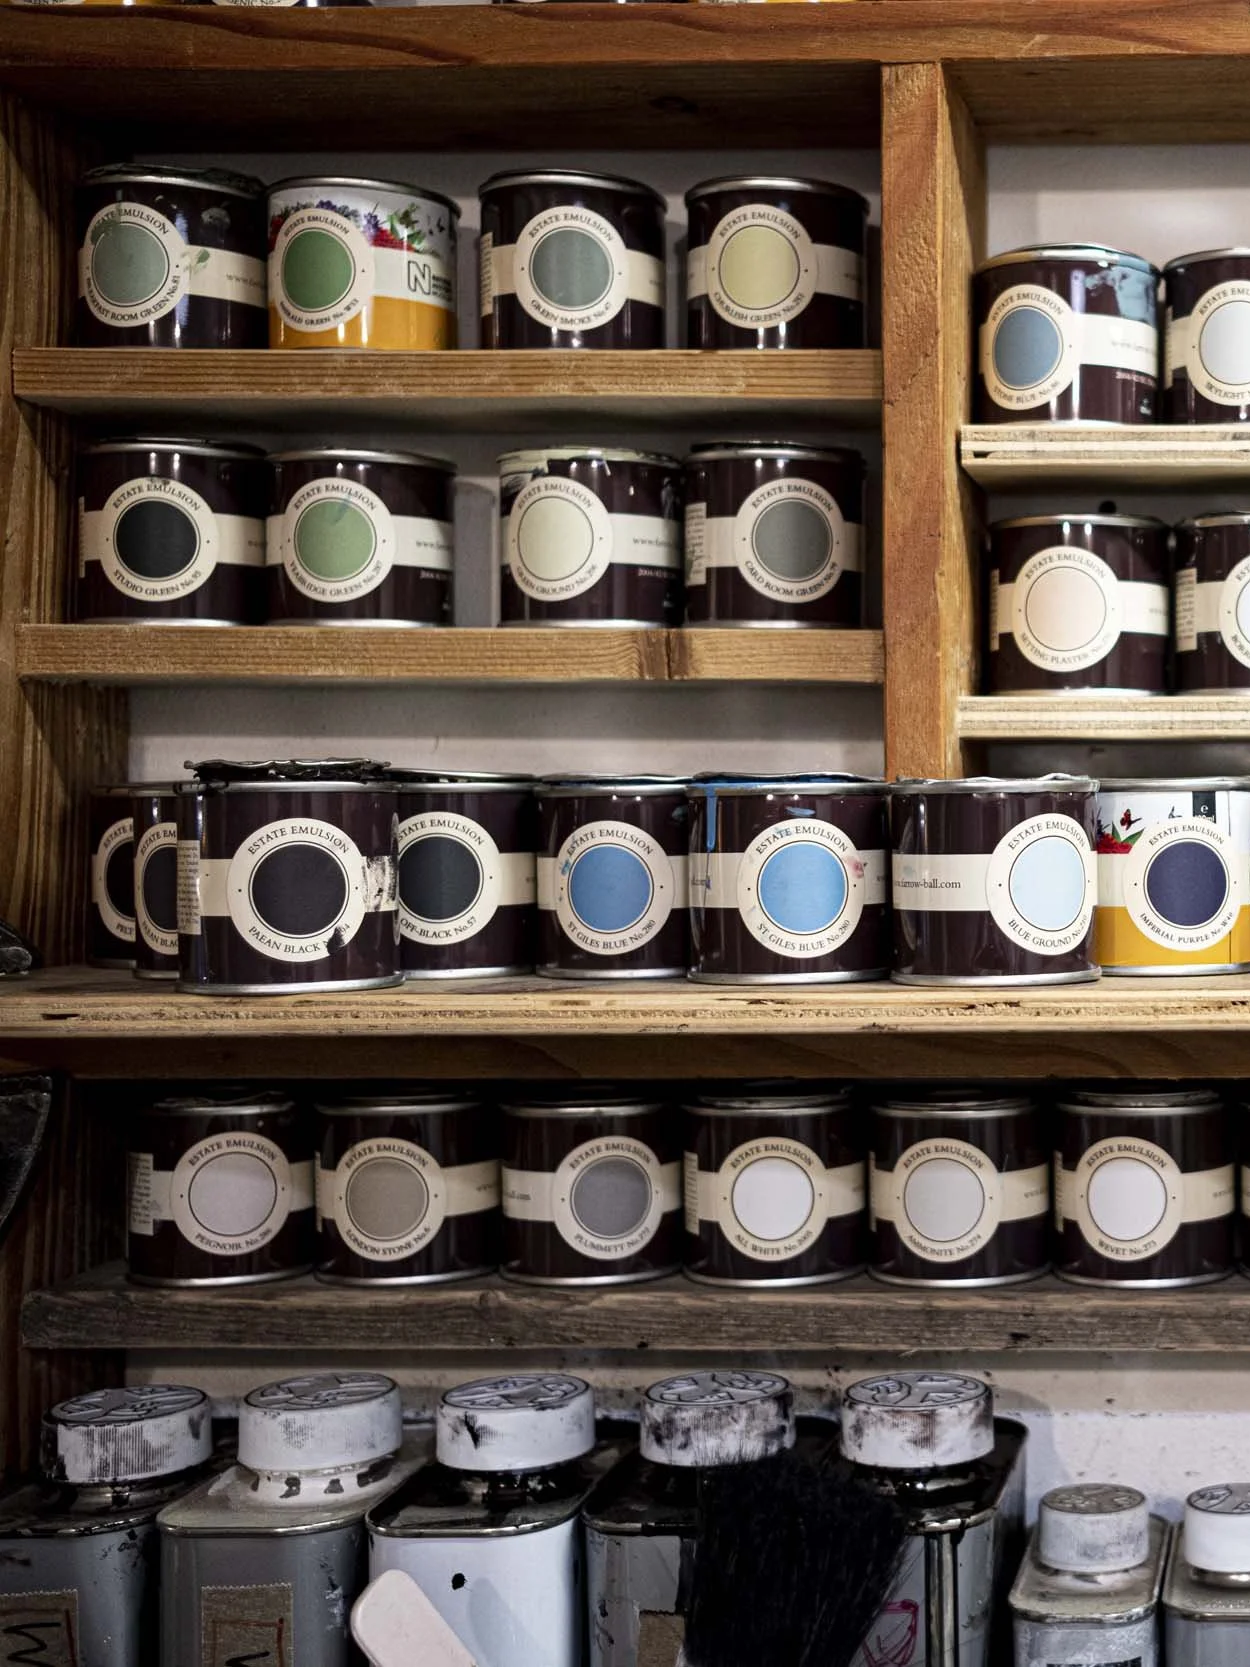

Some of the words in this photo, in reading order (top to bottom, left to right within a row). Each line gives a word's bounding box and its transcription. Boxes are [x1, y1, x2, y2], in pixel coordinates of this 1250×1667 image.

[116, 208, 170, 236] EMULSION
[527, 213, 560, 239] ESTATE
[562, 212, 613, 242] EMULSION
[717, 211, 749, 238] ESTATE
[750, 210, 801, 240] EMULSION
[109, 311, 138, 322] ROOM
[139, 294, 170, 318] GREEN
[529, 298, 559, 322] GREEN
[111, 484, 142, 509] ESTATE
[145, 482, 202, 511] EMULSION
[292, 485, 322, 511] ESTATE
[750, 484, 783, 509] ESTATE
[786, 482, 834, 512] EMULSION
[112, 568, 144, 594] STUDIO
[144, 583, 180, 595] GREEN
[329, 580, 363, 596] GREEN
[743, 559, 765, 585] CARD
[763, 580, 793, 596] ROOM
[246, 826, 286, 855] ESTATE
[290, 824, 349, 855] EMULSION
[395, 819, 428, 843] STATE
[428, 817, 485, 846] EMULSION
[565, 829, 596, 856] ESTATE
[598, 827, 654, 856] EMULSION
[754, 826, 792, 854] ESTATE
[793, 825, 848, 853] EMULSION
[1006, 822, 1042, 850] ESTATE
[1045, 820, 1086, 848] EMULSION
[1147, 824, 1180, 846] ESTATE
[1181, 823, 1225, 845] EMULSION
[247, 925, 282, 951] PAEAN
[283, 941, 321, 954] BLACK
[398, 916, 452, 939] OFF-BLACK
[453, 915, 478, 935] No.57
[567, 919, 577, 933] ST
[575, 929, 600, 948] GILES
[601, 937, 629, 949] BLUE
[628, 918, 657, 944] No.280
[756, 922, 768, 936] ST
[766, 931, 796, 951] GILES
[798, 938, 826, 952] BLUE
[825, 918, 851, 945] No.280
[1007, 917, 1031, 941] BLUE
[1031, 933, 1072, 948] GROUND
[1138, 911, 1174, 942] IMPERIAL
[1177, 932, 1210, 945] PURPLE
[187, 1139, 223, 1167] ESTATE
[225, 1137, 278, 1161] EMULSION
[343, 1144, 374, 1169] ESTATE
[375, 1142, 429, 1167] EMULSION
[568, 1144, 602, 1169] ESTATE
[729, 1144, 762, 1169] ESTATE
[763, 1142, 814, 1167] EMULSION
[902, 1144, 932, 1169] ESTATE
[933, 1143, 984, 1169] EMULSION
[1085, 1143, 1114, 1167] ESTATE
[1115, 1142, 1167, 1168] EMULSION
[345, 1228, 380, 1255] LONDON
[380, 1240, 414, 1256] STONE
[749, 1242, 780, 1255] WHITE
[906, 1232, 955, 1256] AMMONITE
